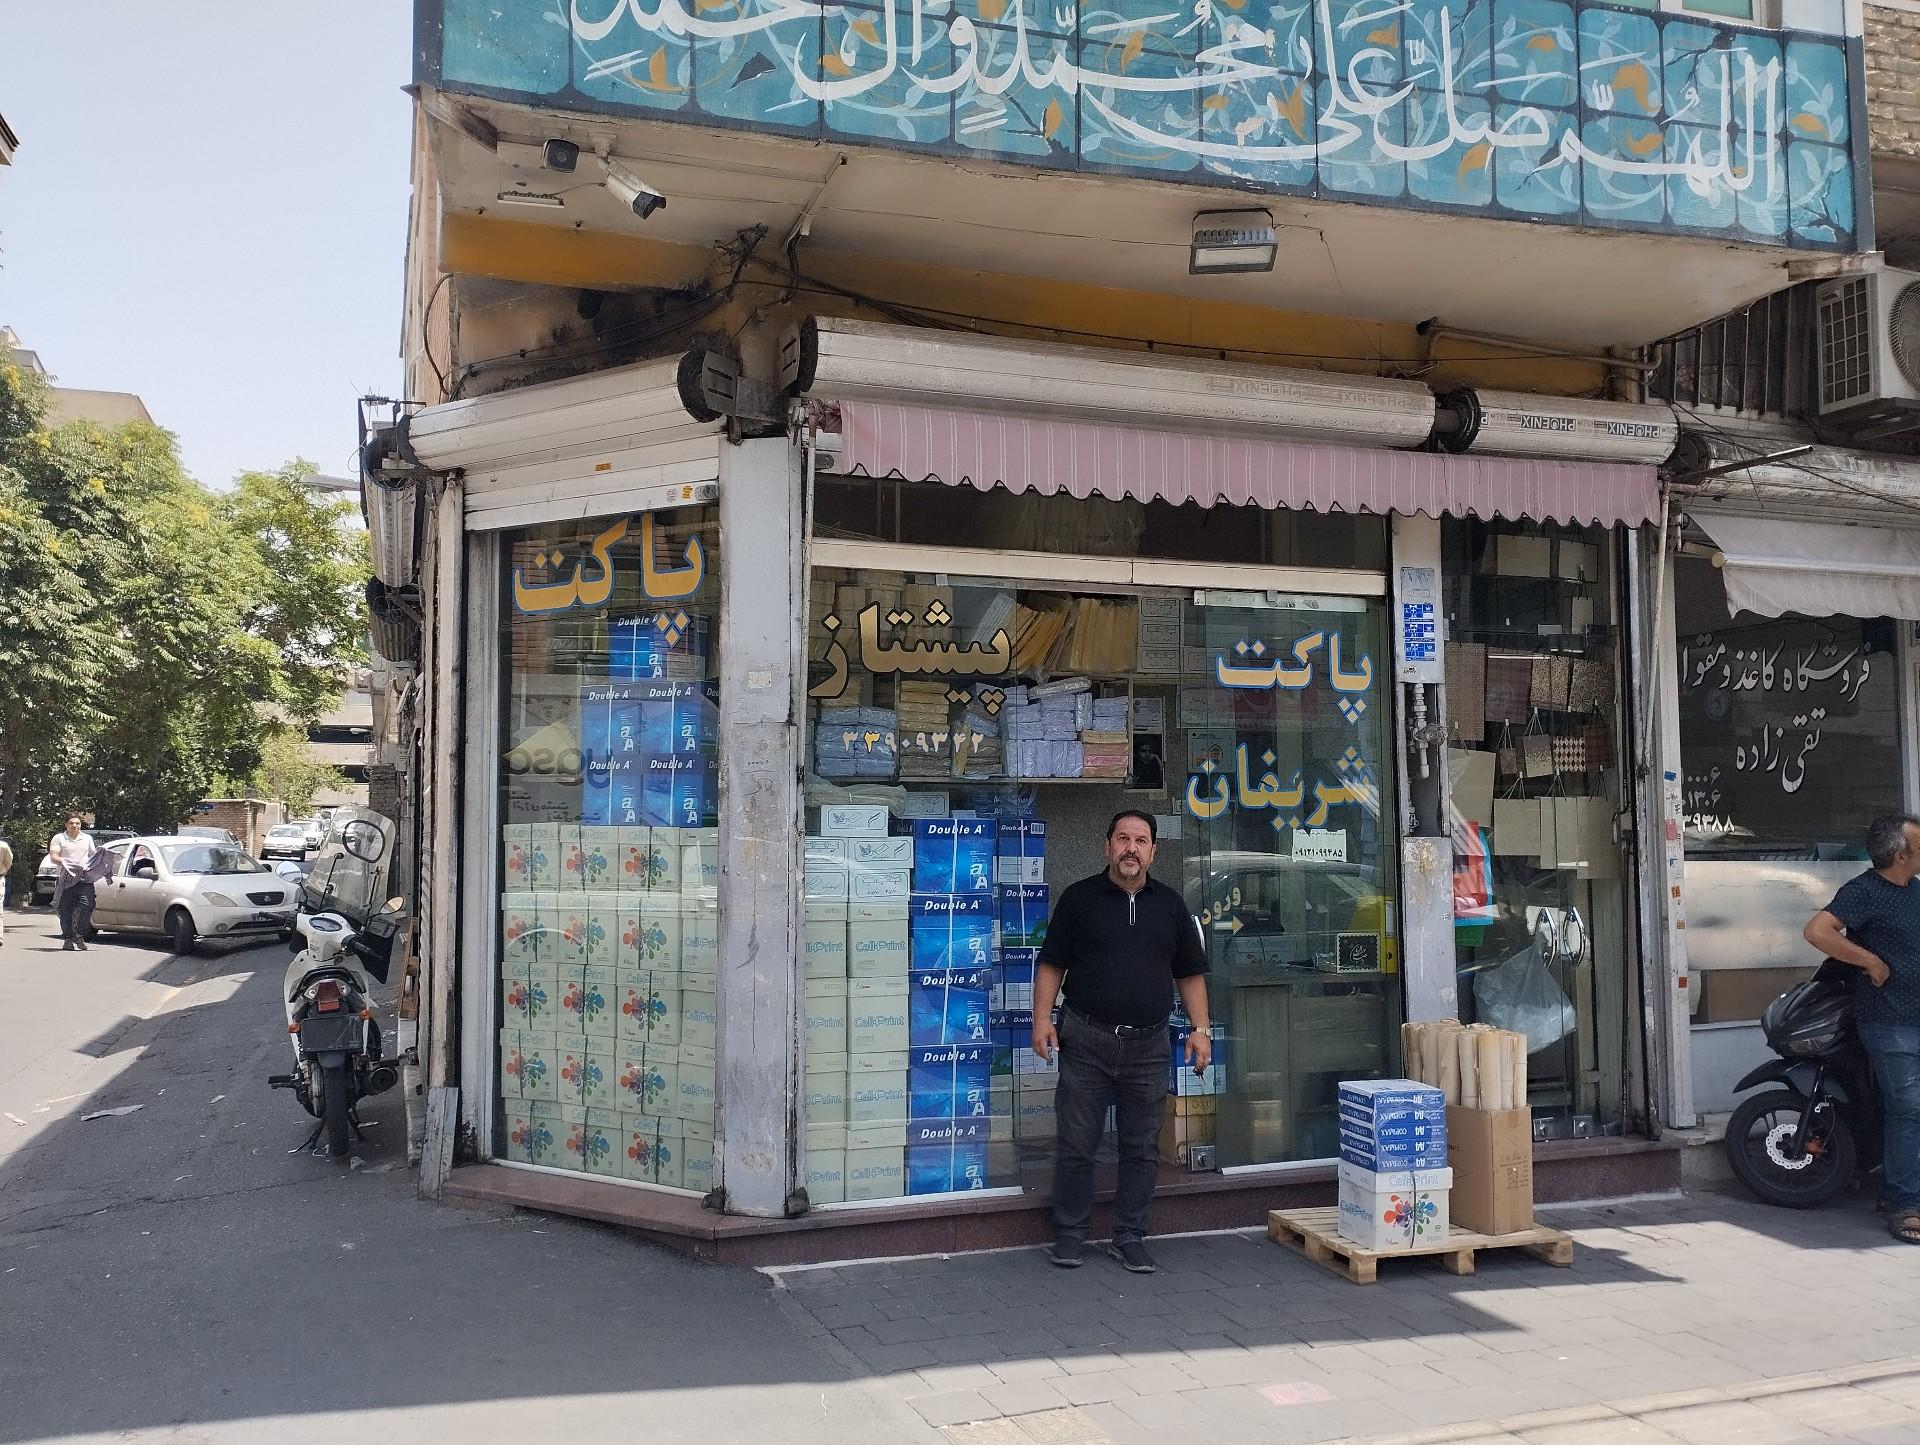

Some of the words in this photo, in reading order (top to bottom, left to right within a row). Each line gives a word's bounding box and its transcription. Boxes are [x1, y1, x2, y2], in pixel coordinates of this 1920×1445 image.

[1521, 415, 1576, 432] PHOENIX
[1607, 422, 1662, 439] PHOENIX
[514, 512, 705, 646] پاکت
[808, 598, 1013, 714] پیشتاز
[1216, 630, 1374, 724] پاکت
[1682, 633, 1726, 688] مقوا
[1733, 639, 1785, 691] کاغذ
[1783, 631, 1872, 702] فروشگاه
[1782, 707, 1826, 793] تقی
[1187, 742, 1374, 832] شریفان
[928, 824, 970, 835] Double
[925, 901, 967, 912] Double
[923, 975, 966, 986] Double
[923, 1051, 966, 1063] Double
[921, 1127, 964, 1139] Double
